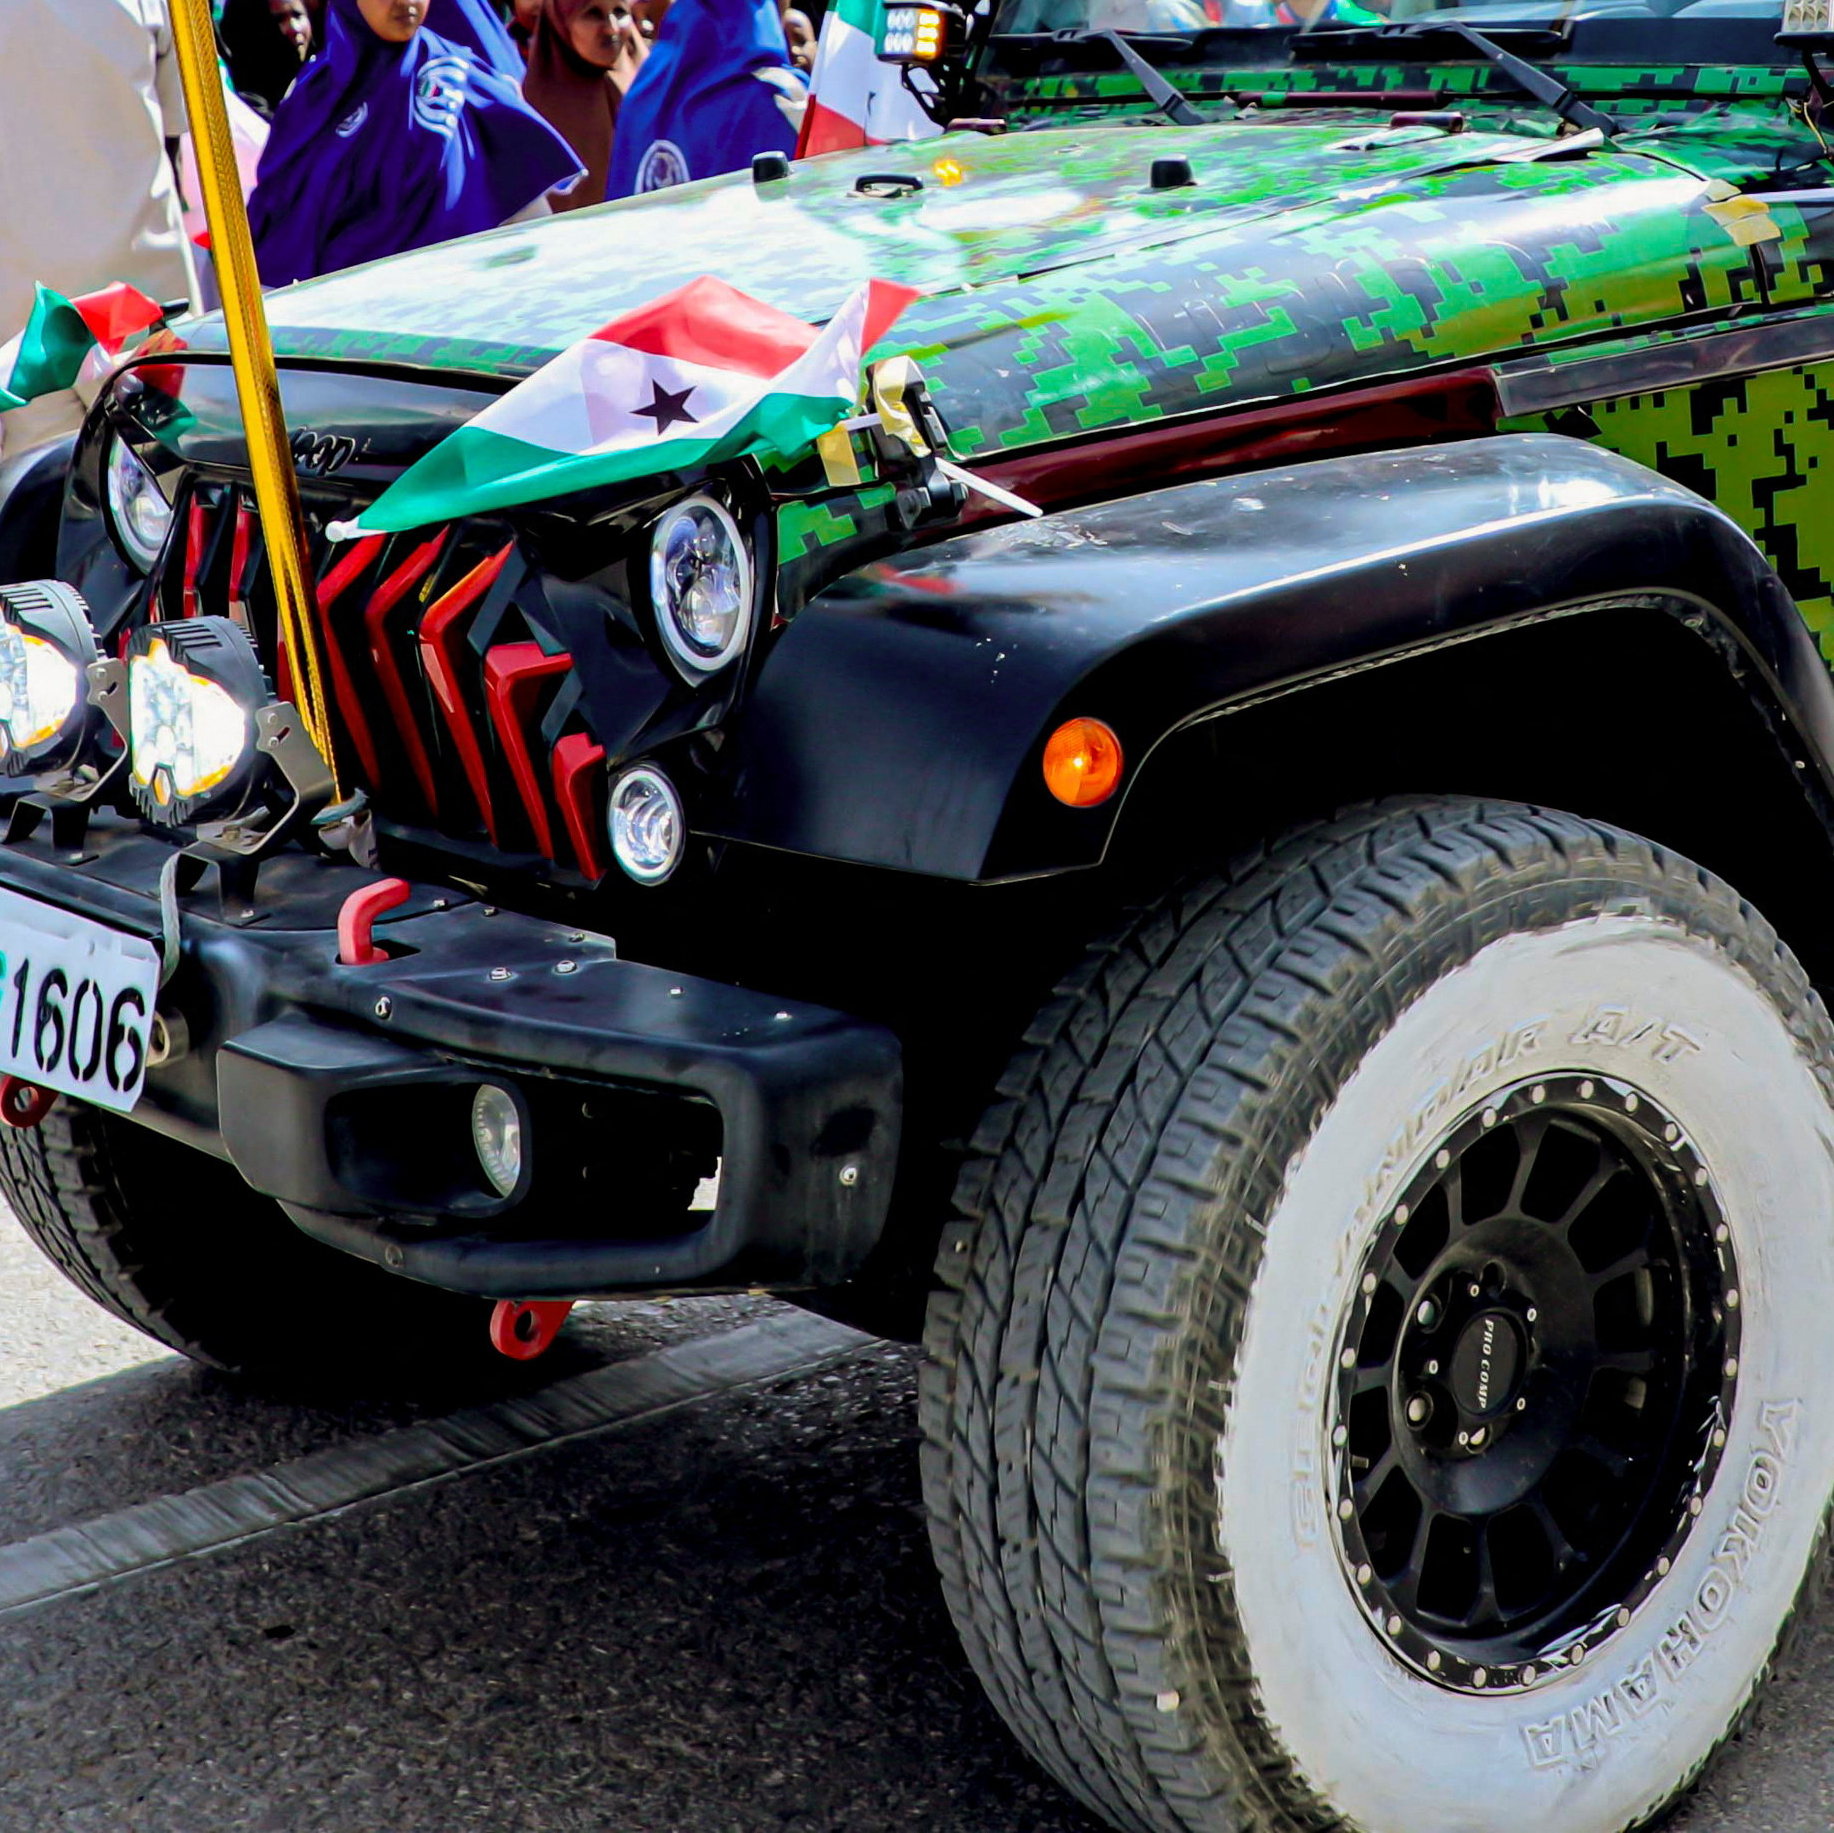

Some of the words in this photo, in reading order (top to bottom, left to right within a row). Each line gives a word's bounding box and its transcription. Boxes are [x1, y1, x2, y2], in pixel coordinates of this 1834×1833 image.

[11, 957, 145, 1094] 1606
[1482, 1318, 1495, 1356] PRO
[1476, 1359, 1491, 1409] COMP
[1523, 1397, 1804, 1768] YOKOHAMA
